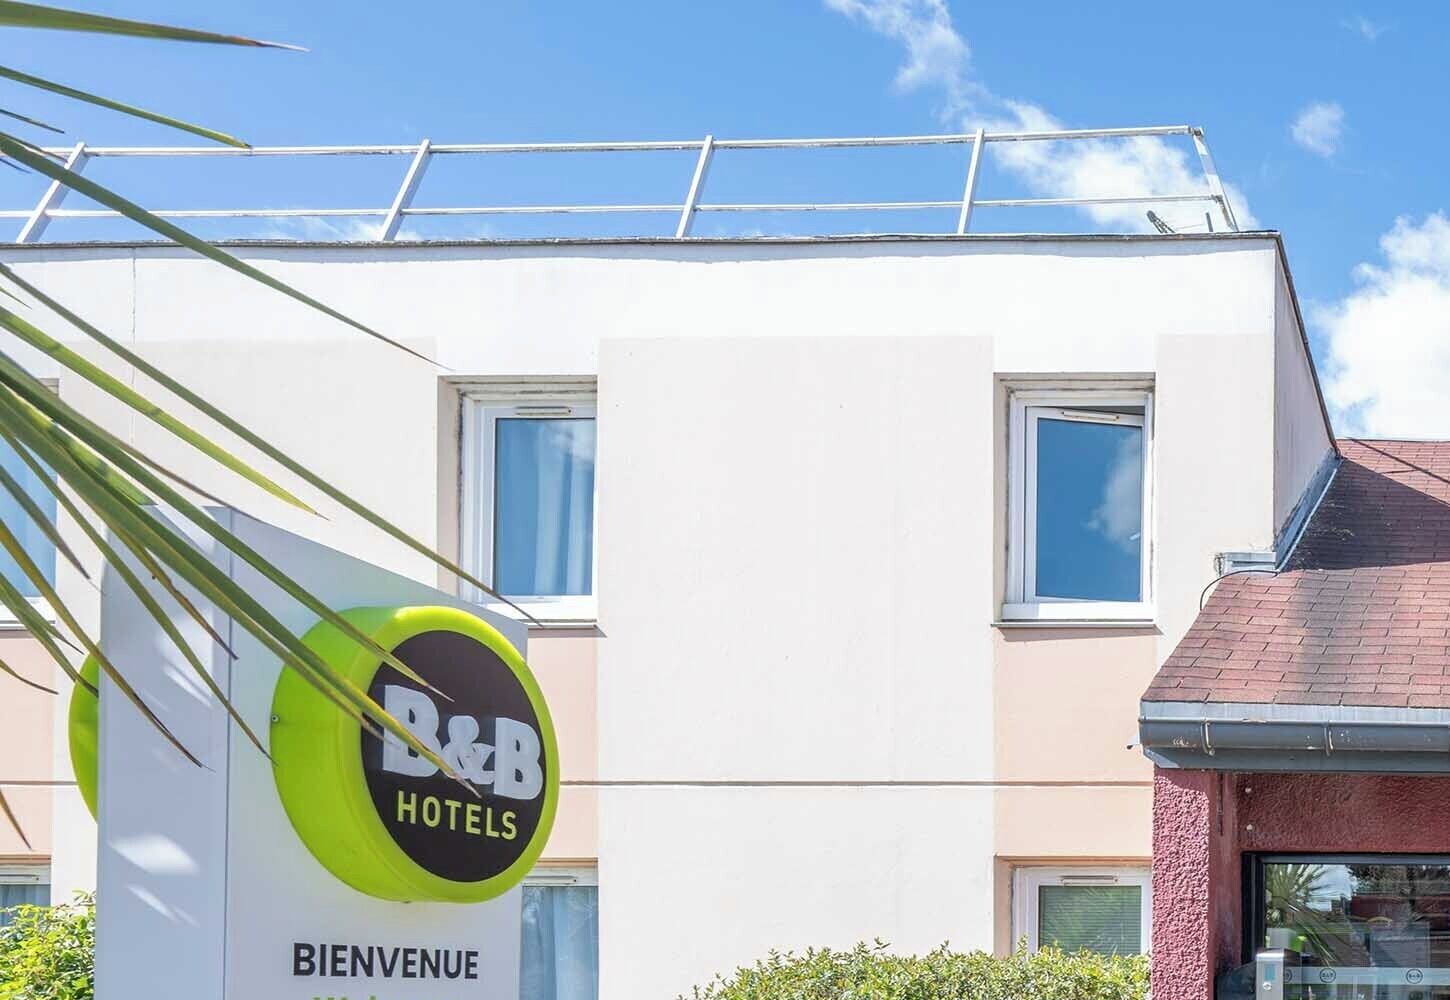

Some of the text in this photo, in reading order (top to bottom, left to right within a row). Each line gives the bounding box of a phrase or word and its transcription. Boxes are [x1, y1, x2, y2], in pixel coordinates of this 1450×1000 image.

[383, 684, 544, 800] B&B
[397, 790, 519, 841] HOTELS
[293, 942, 479, 980] BIENVENUE
